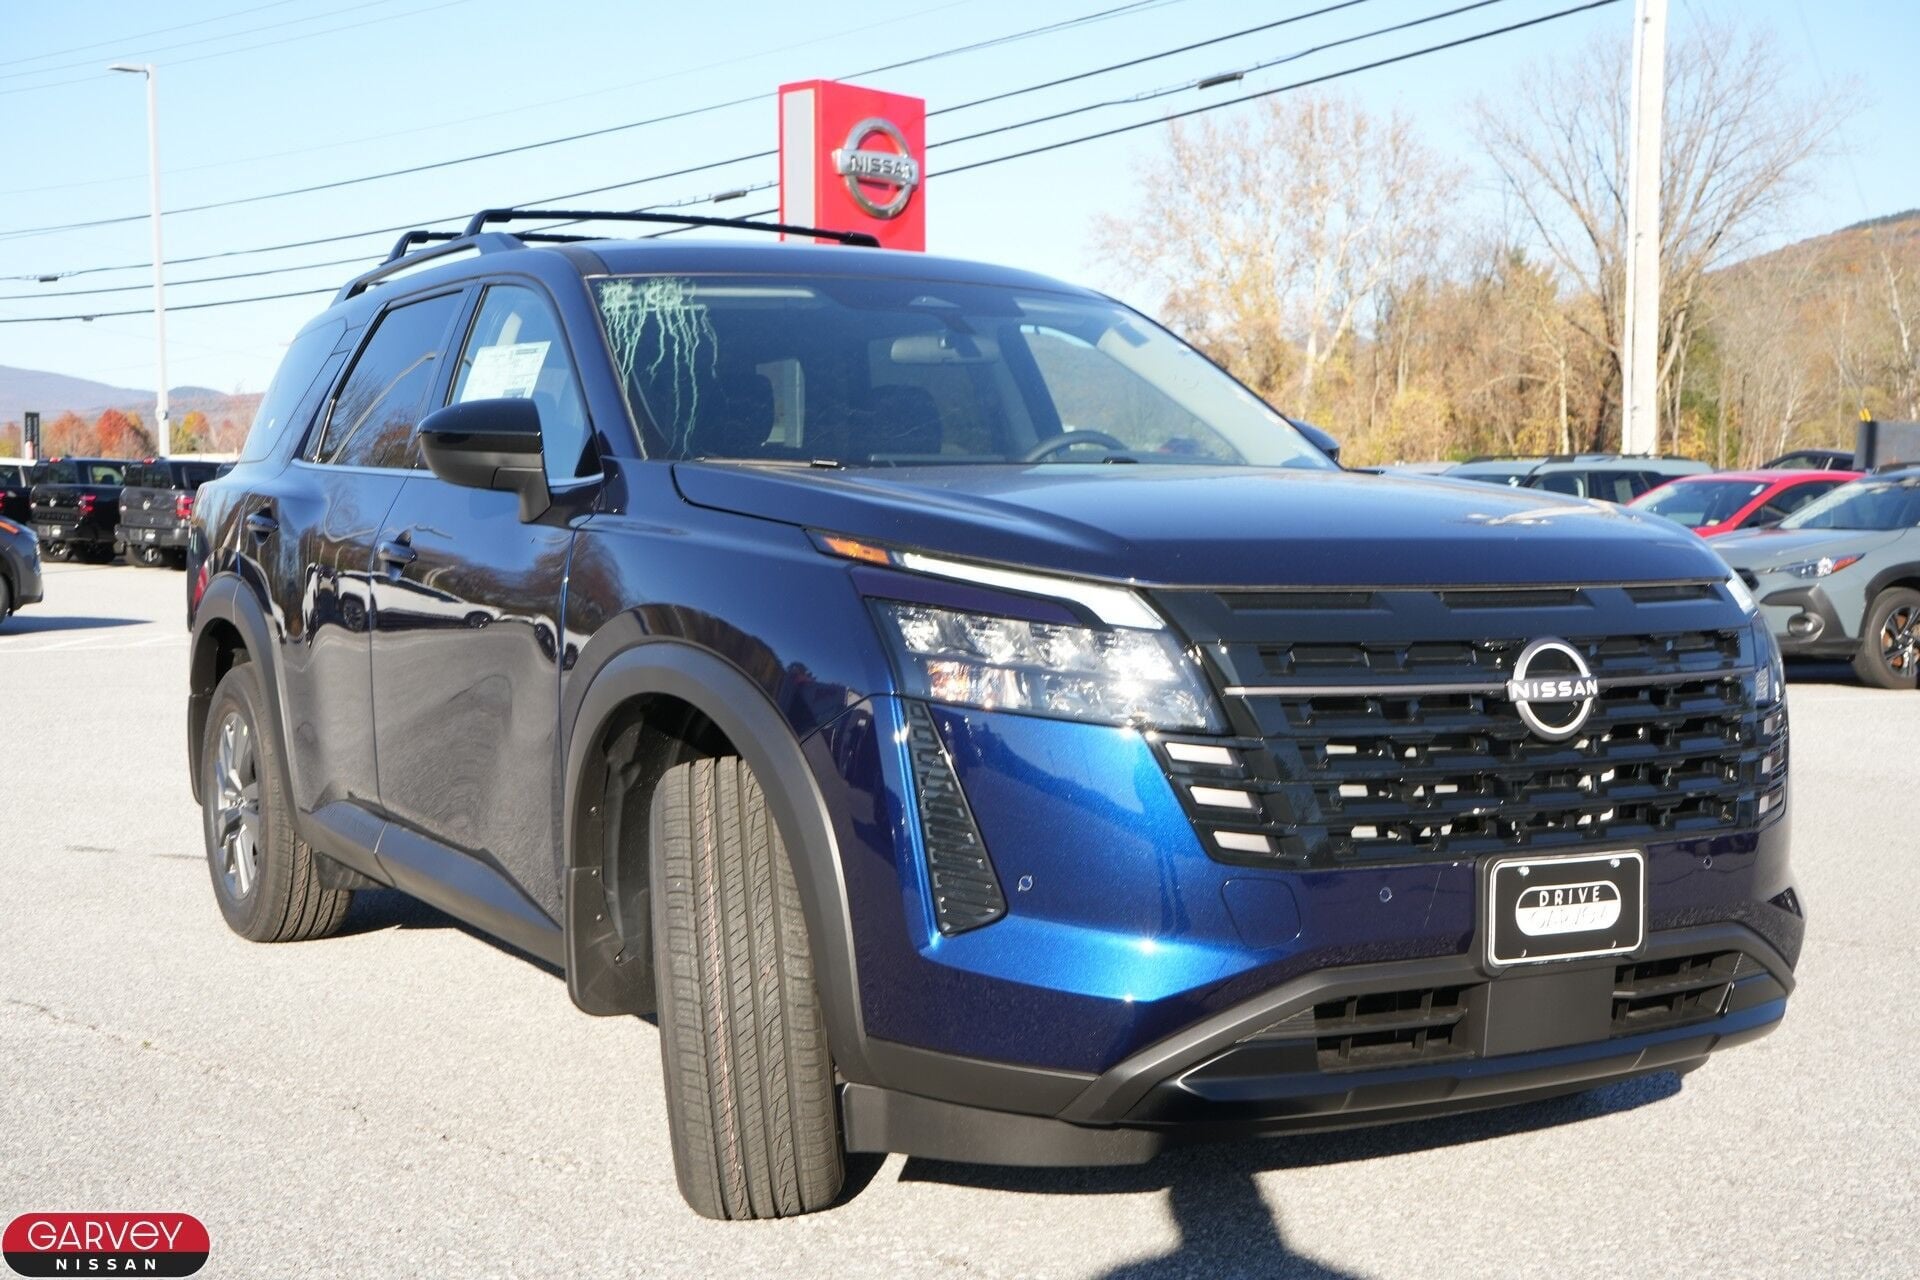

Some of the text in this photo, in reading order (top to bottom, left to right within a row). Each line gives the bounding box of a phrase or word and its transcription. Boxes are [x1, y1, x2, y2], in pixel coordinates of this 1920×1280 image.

[850, 155, 913, 178] NISSAN
[1511, 680, 1598, 699] NISSAN
[1539, 885, 1601, 907] DRIVE
